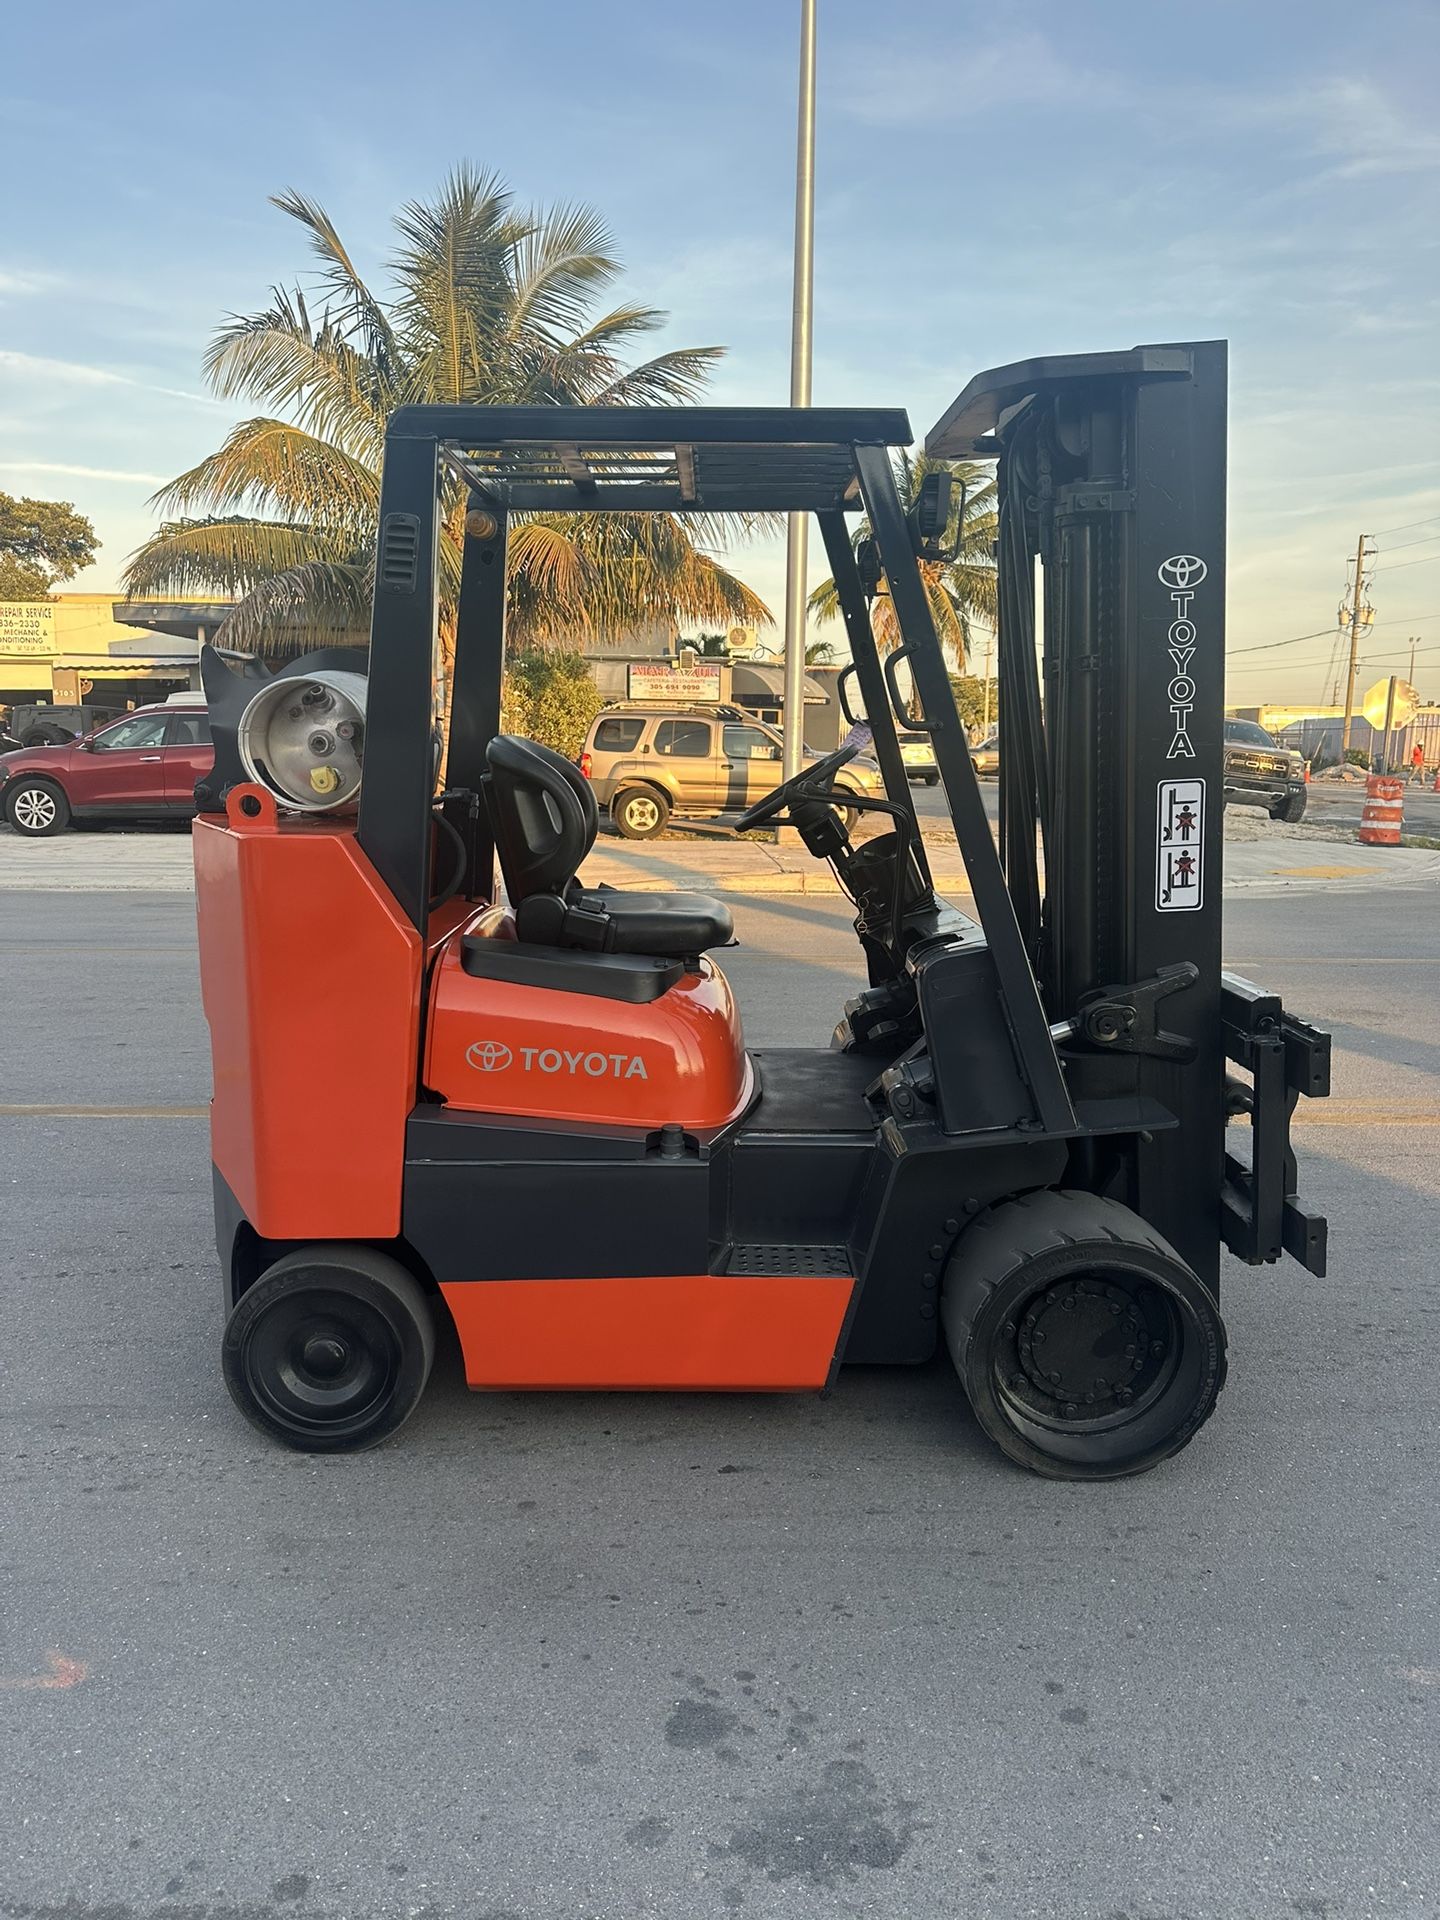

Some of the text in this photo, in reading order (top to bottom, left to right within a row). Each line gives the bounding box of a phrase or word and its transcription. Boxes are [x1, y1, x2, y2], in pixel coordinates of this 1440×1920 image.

[26, 608, 51, 619] SERVICE
[1166, 591, 1196, 759] TOYOTA
[1231, 759, 1286, 771] FORD
[520, 1047, 648, 1080] TOYOTA
